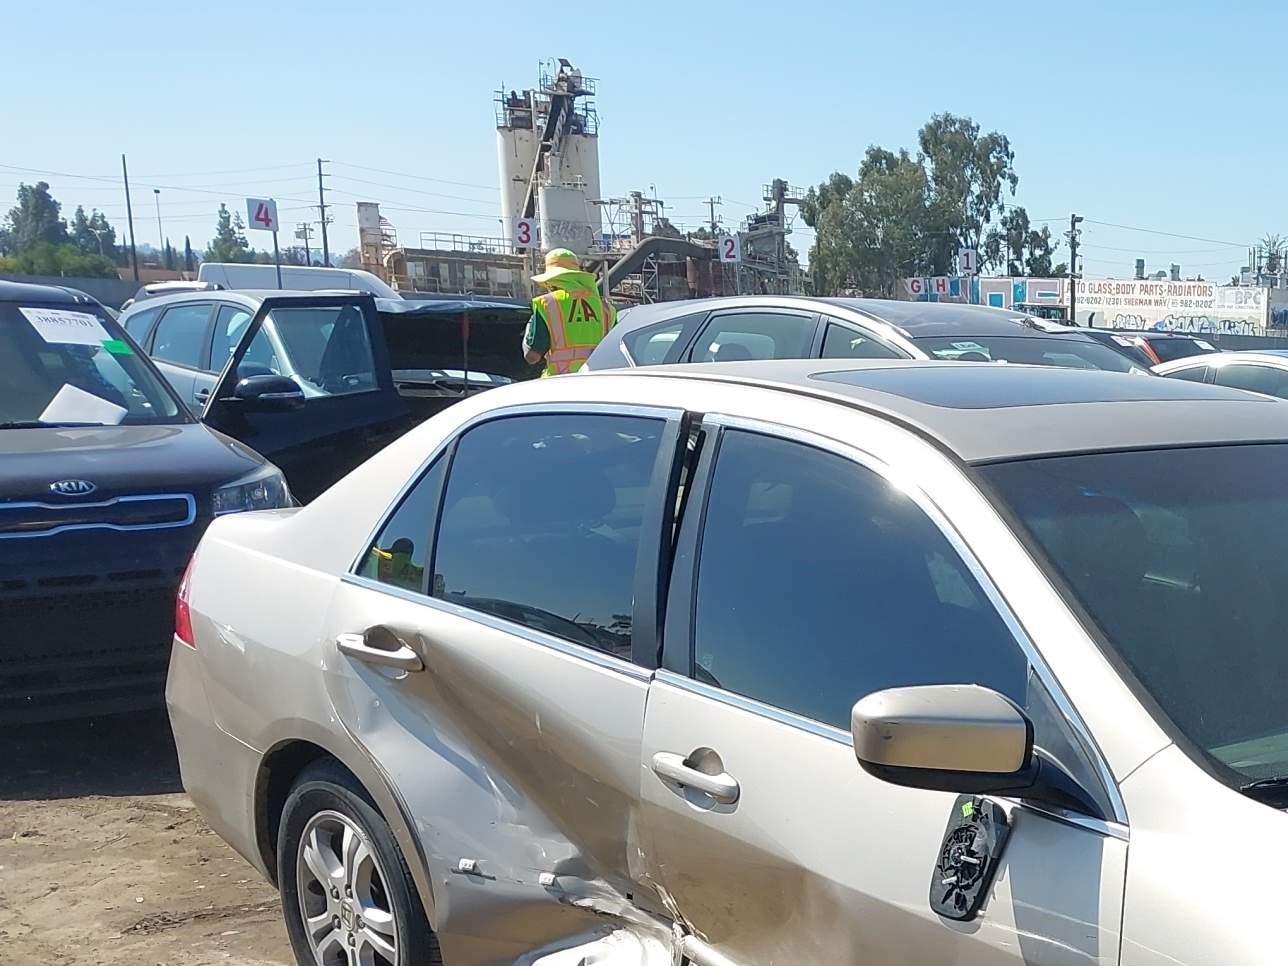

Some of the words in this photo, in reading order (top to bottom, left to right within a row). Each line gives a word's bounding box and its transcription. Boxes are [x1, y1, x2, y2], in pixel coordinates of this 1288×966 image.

[255, 202, 272, 227] 4
[517, 221, 531, 244] 3
[723, 238, 736, 259] 2
[963, 252, 972, 270] 1
[910, 279, 922, 293] G
[936, 278, 946, 293] H
[1065, 281, 1086, 294] ATO
[1124, 298, 1152, 307] SHERMAN
[1179, 299, 1213, 309] 982-0202
[1235, 290, 1262, 305] BPC
[59, 481, 90, 492] KIA
